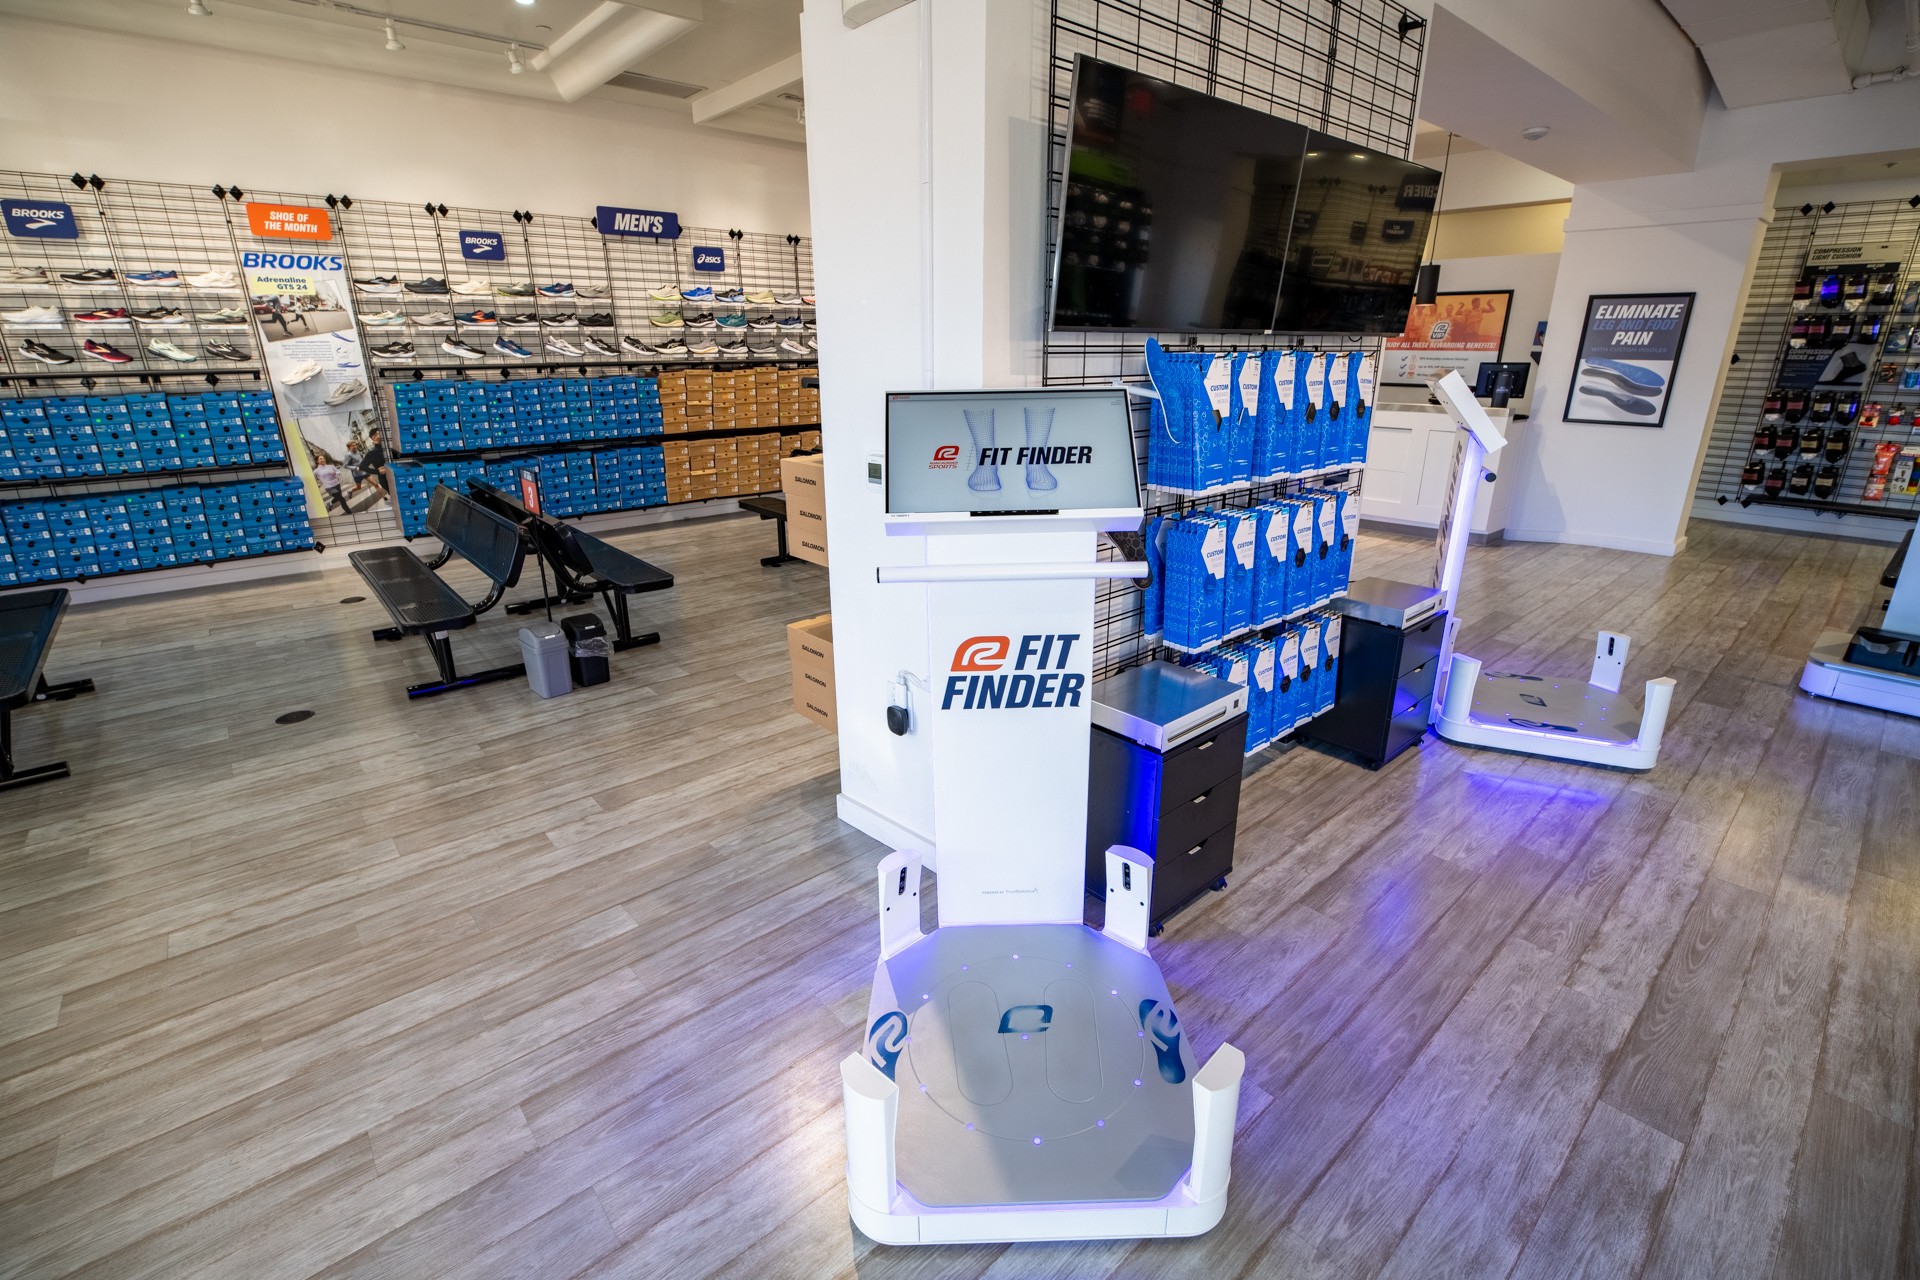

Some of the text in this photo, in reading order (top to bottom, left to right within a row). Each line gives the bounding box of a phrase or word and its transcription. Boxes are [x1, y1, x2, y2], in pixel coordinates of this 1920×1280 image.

[11, 208, 65, 219] BROOKS
[269, 211, 308, 222] SHOE OF
[264, 221, 318, 233] THE MONTH
[614, 212, 664, 234] MEN'S
[465, 236, 498, 246] BROOKS
[243, 252, 342, 270] BROOKS
[1595, 304, 1684, 319] ELIMINATE
[1593, 320, 1678, 330] LEG AND FOOT
[1611, 332, 1654, 345] PAIN
[979, 448, 1012, 466] FIT
[1016, 446, 1092, 465] FINDER
[795, 476, 816, 486] SALOMON
[800, 510, 822, 520] SALOMON
[1270, 534, 1286, 542] CUSTOM
[802, 541, 824, 552] SALOMON
[1237, 541, 1253, 549] CUSTOM
[1207, 549, 1224, 558] CUSTOM
[1328, 635, 1339, 643] CUSTOM
[802, 644, 824, 658] SALOMON
[1014, 634, 1080, 670] FIT
[1304, 645, 1318, 653] CUSTOM
[1283, 655, 1297, 664] CUSTOM
[1258, 667, 1273, 676] CUSTOM
[805, 673, 826, 687] SALOMON
[941, 673, 1085, 710] FINDER
[807, 702, 828, 717] SALOMON
